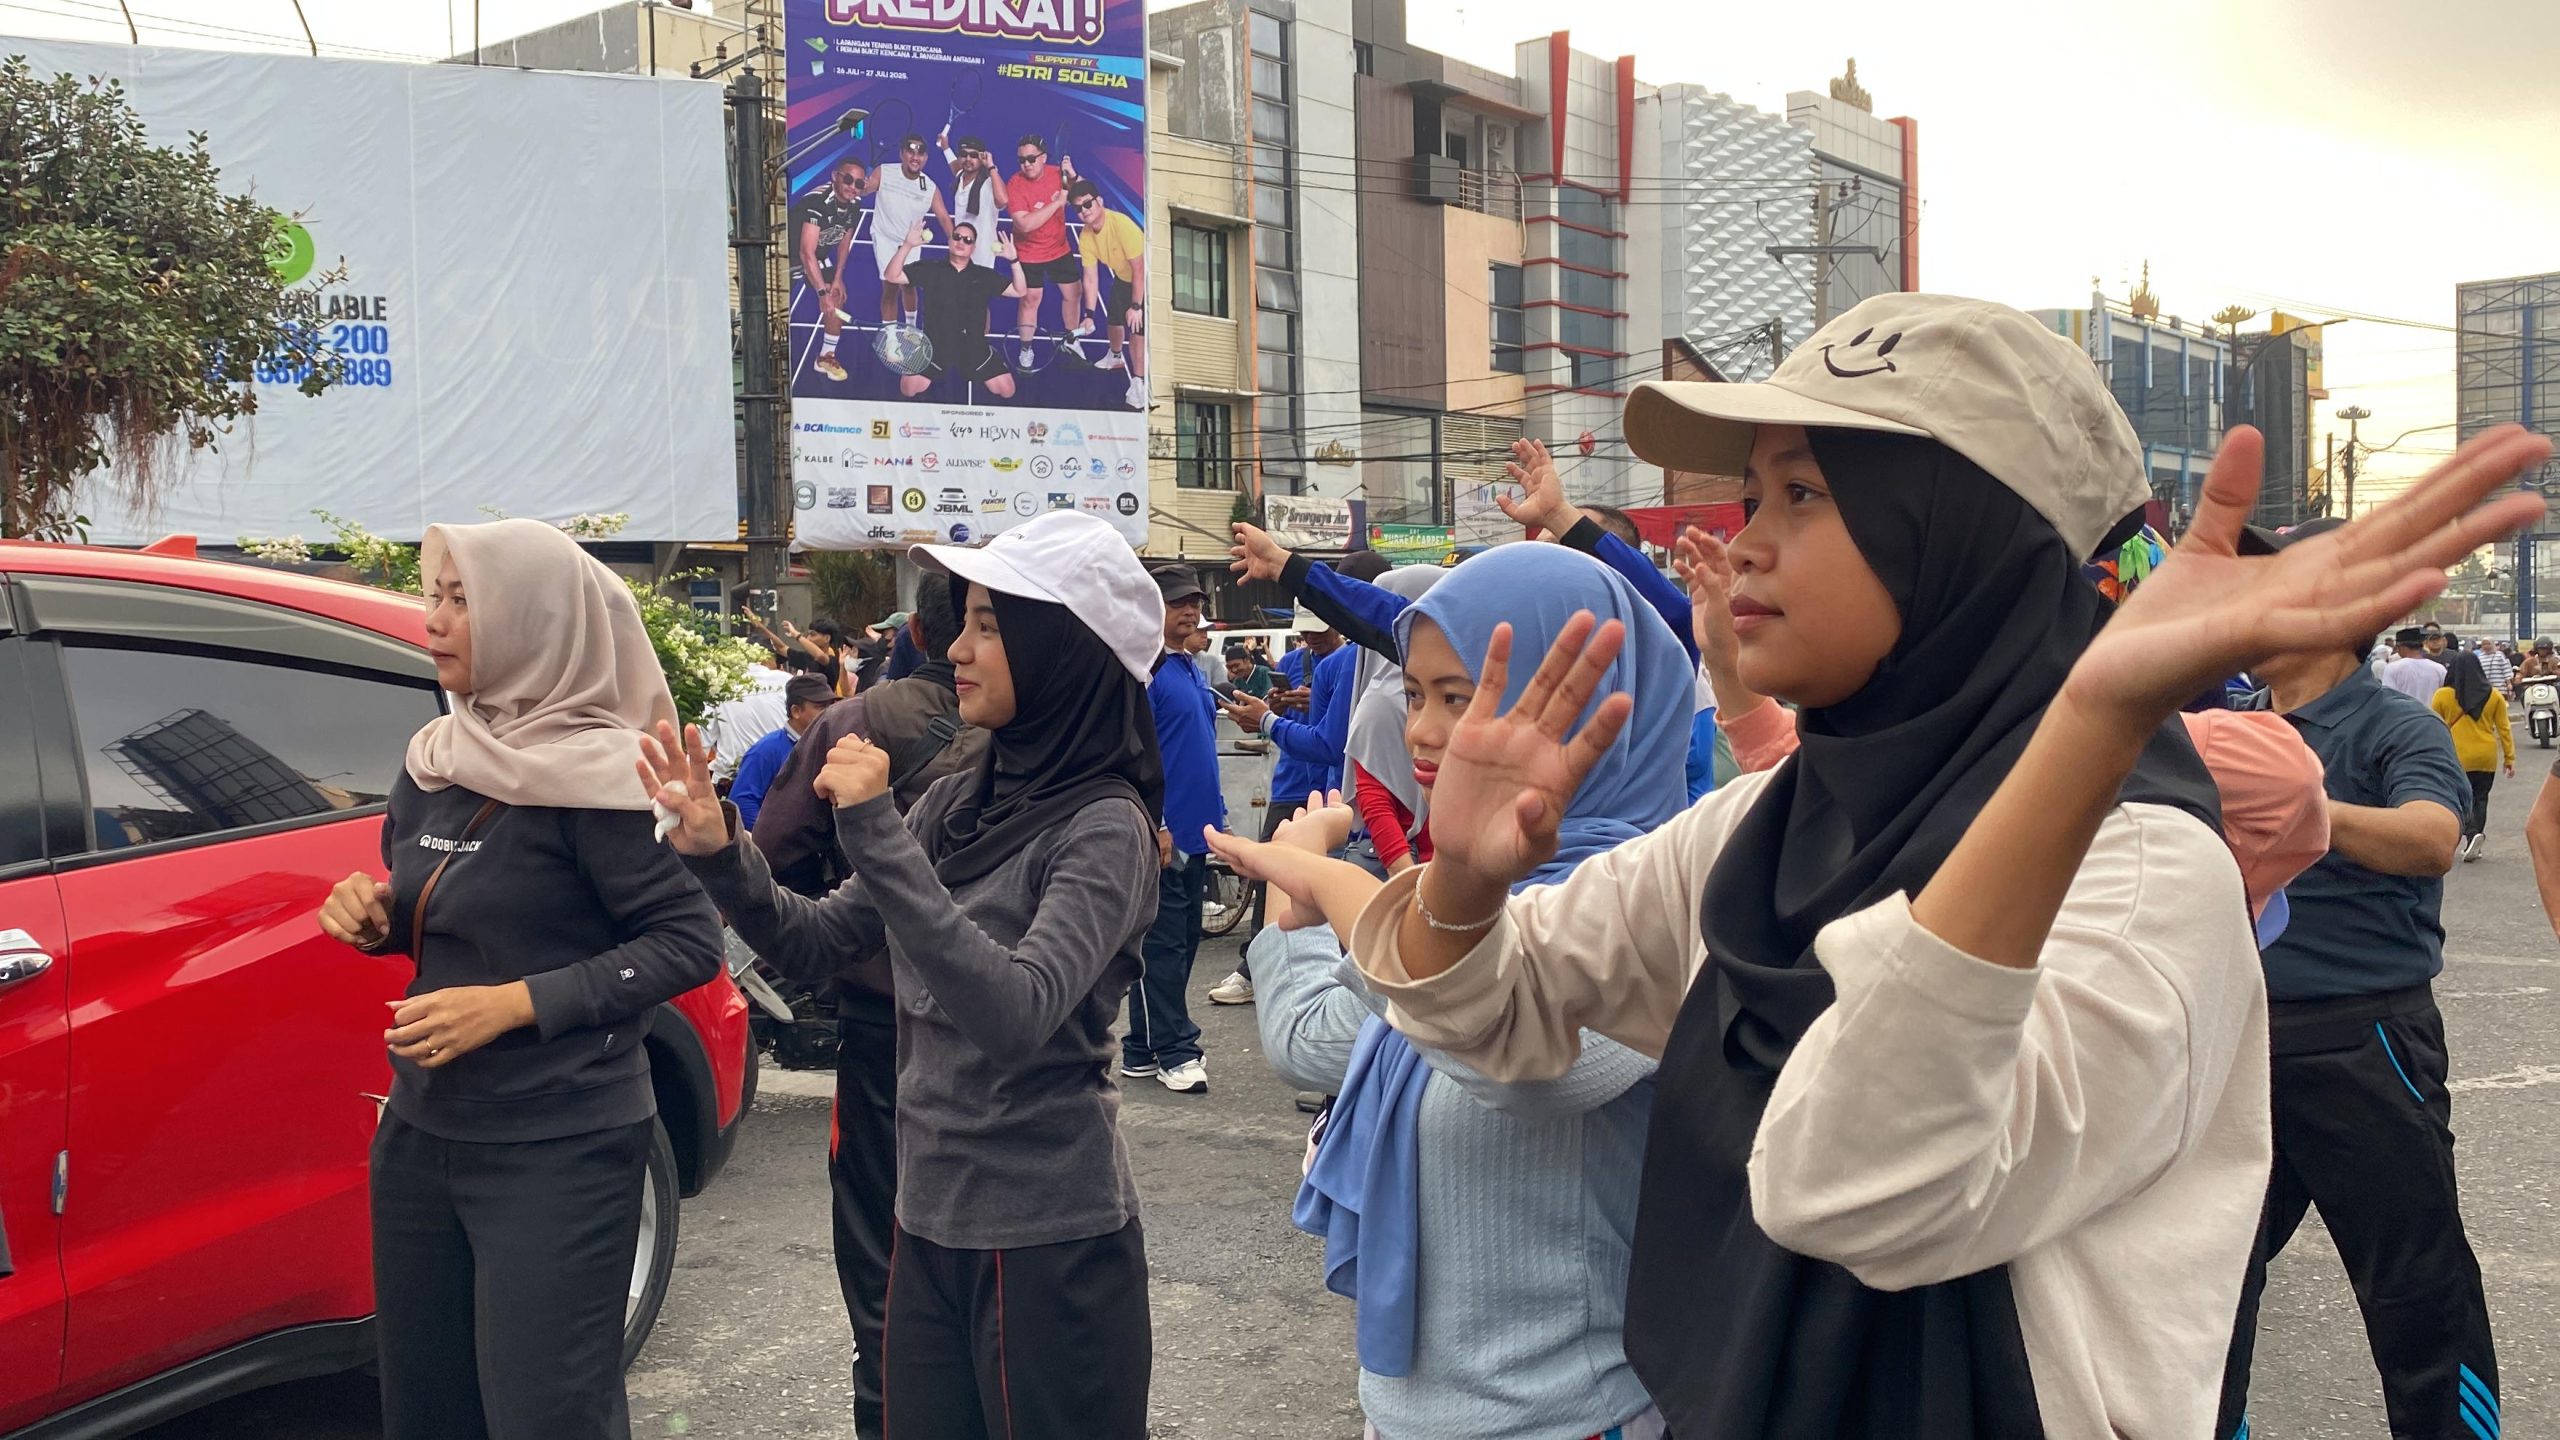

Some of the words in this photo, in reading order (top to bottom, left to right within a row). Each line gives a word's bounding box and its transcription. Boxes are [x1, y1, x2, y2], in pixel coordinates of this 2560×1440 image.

[912, 45, 942, 54] KENCANA
[1035, 55, 1078, 65] SUPPORT
[865, 69, 874, 77] 27
[874, 70, 888, 78] JULI
[997, 63, 1053, 81] #ISTRI
[1057, 68, 1128, 88] SOLEHA
[872, 421, 889, 436] 51
[804, 455, 834, 463] KALBE
[934, 504, 973, 513] JBML
[867, 526, 895, 538] difes
[1383, 533, 1414, 545] TURKEY
[1416, 535, 1444, 546] CARPET
